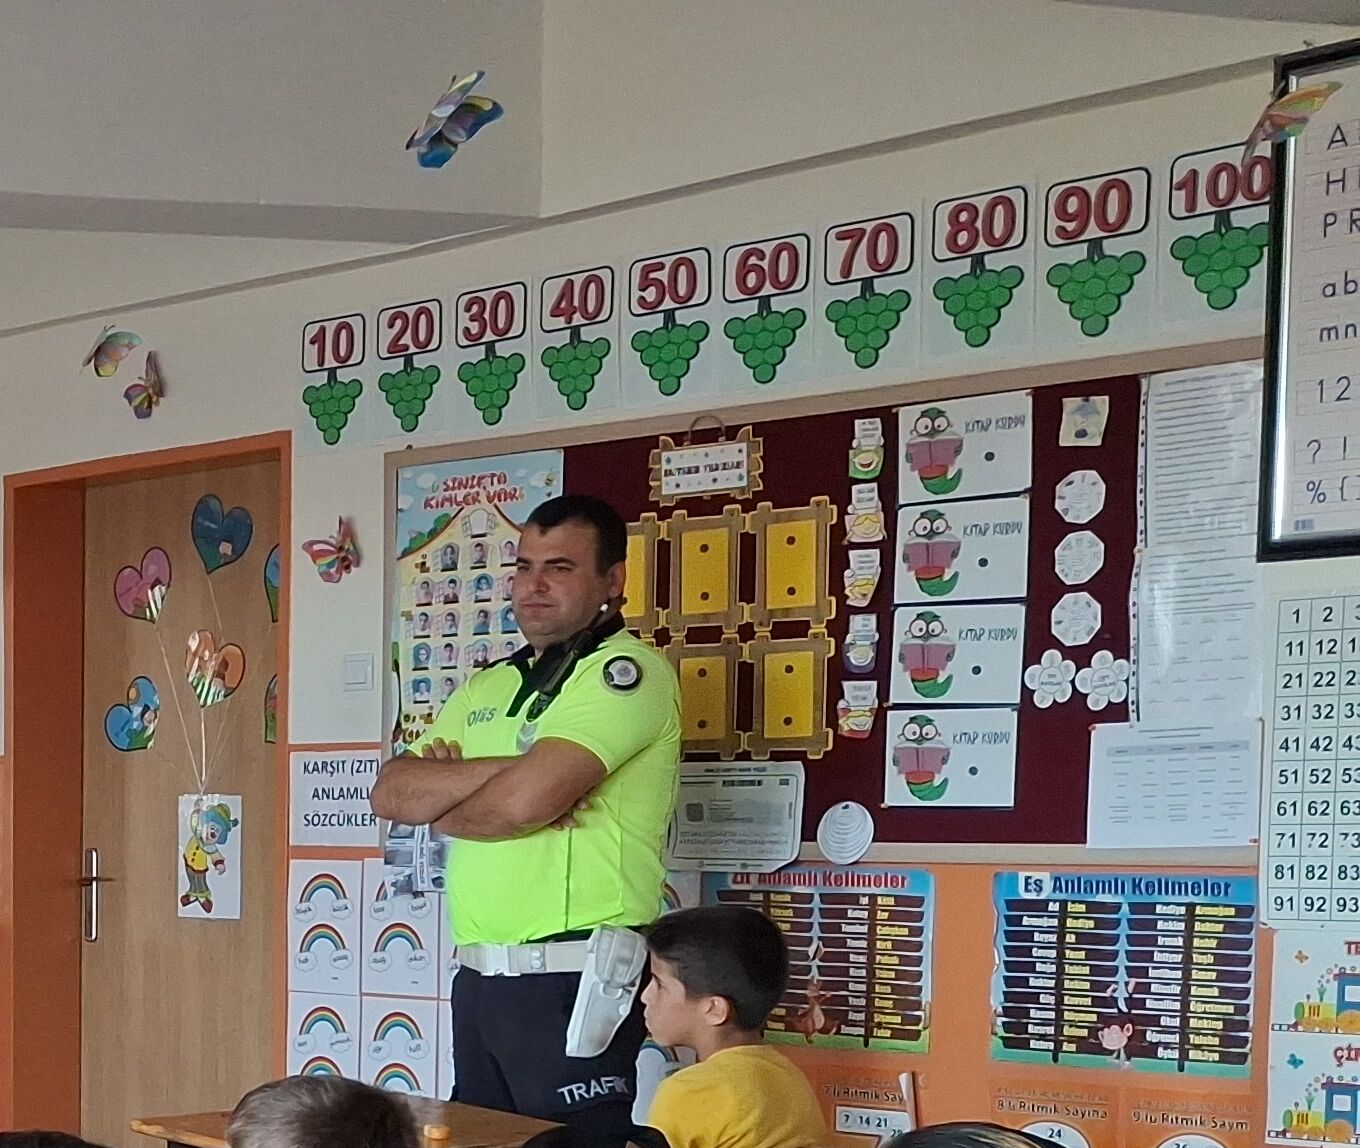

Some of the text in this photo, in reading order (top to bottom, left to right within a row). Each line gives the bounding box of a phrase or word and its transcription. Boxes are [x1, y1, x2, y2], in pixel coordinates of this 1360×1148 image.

[1173, 154, 1273, 214] 100
[1053, 177, 1132, 240] 90
[944, 195, 1017, 255] 80
[835, 221, 900, 280] 70
[735, 241, 799, 297] 60
[637, 256, 698, 311] 50
[549, 273, 605, 325] 40
[462, 290, 515, 343] 30
[386, 306, 435, 355] 20
[309, 322, 354, 367] 10
[1292, 606, 1333, 624] 1 2
[1285, 638, 1338, 656] 11 12
[1282, 670, 1336, 689] 21 22
[1280, 703, 1334, 721] 31 32
[1279, 735, 1333, 753] 41 42
[303, 760, 347, 778] KARŞIT
[1278, 768, 1332, 785] 51 52
[1276, 800, 1297, 816] 61
[1307, 800, 1330, 816] 62
[303, 809, 378, 827] SÖZCÜKLER
[1275, 832, 1329, 848] 71 72
[823, 871, 908, 889] Kelimeler
[1274, 864, 1295, 880] 81
[1305, 864, 1328, 880] 82
[1023, 875, 1232, 897] Eş Anlamlı Kelimeler
[1273, 896, 1294, 912] 91
[1304, 896, 1327, 913] 92
